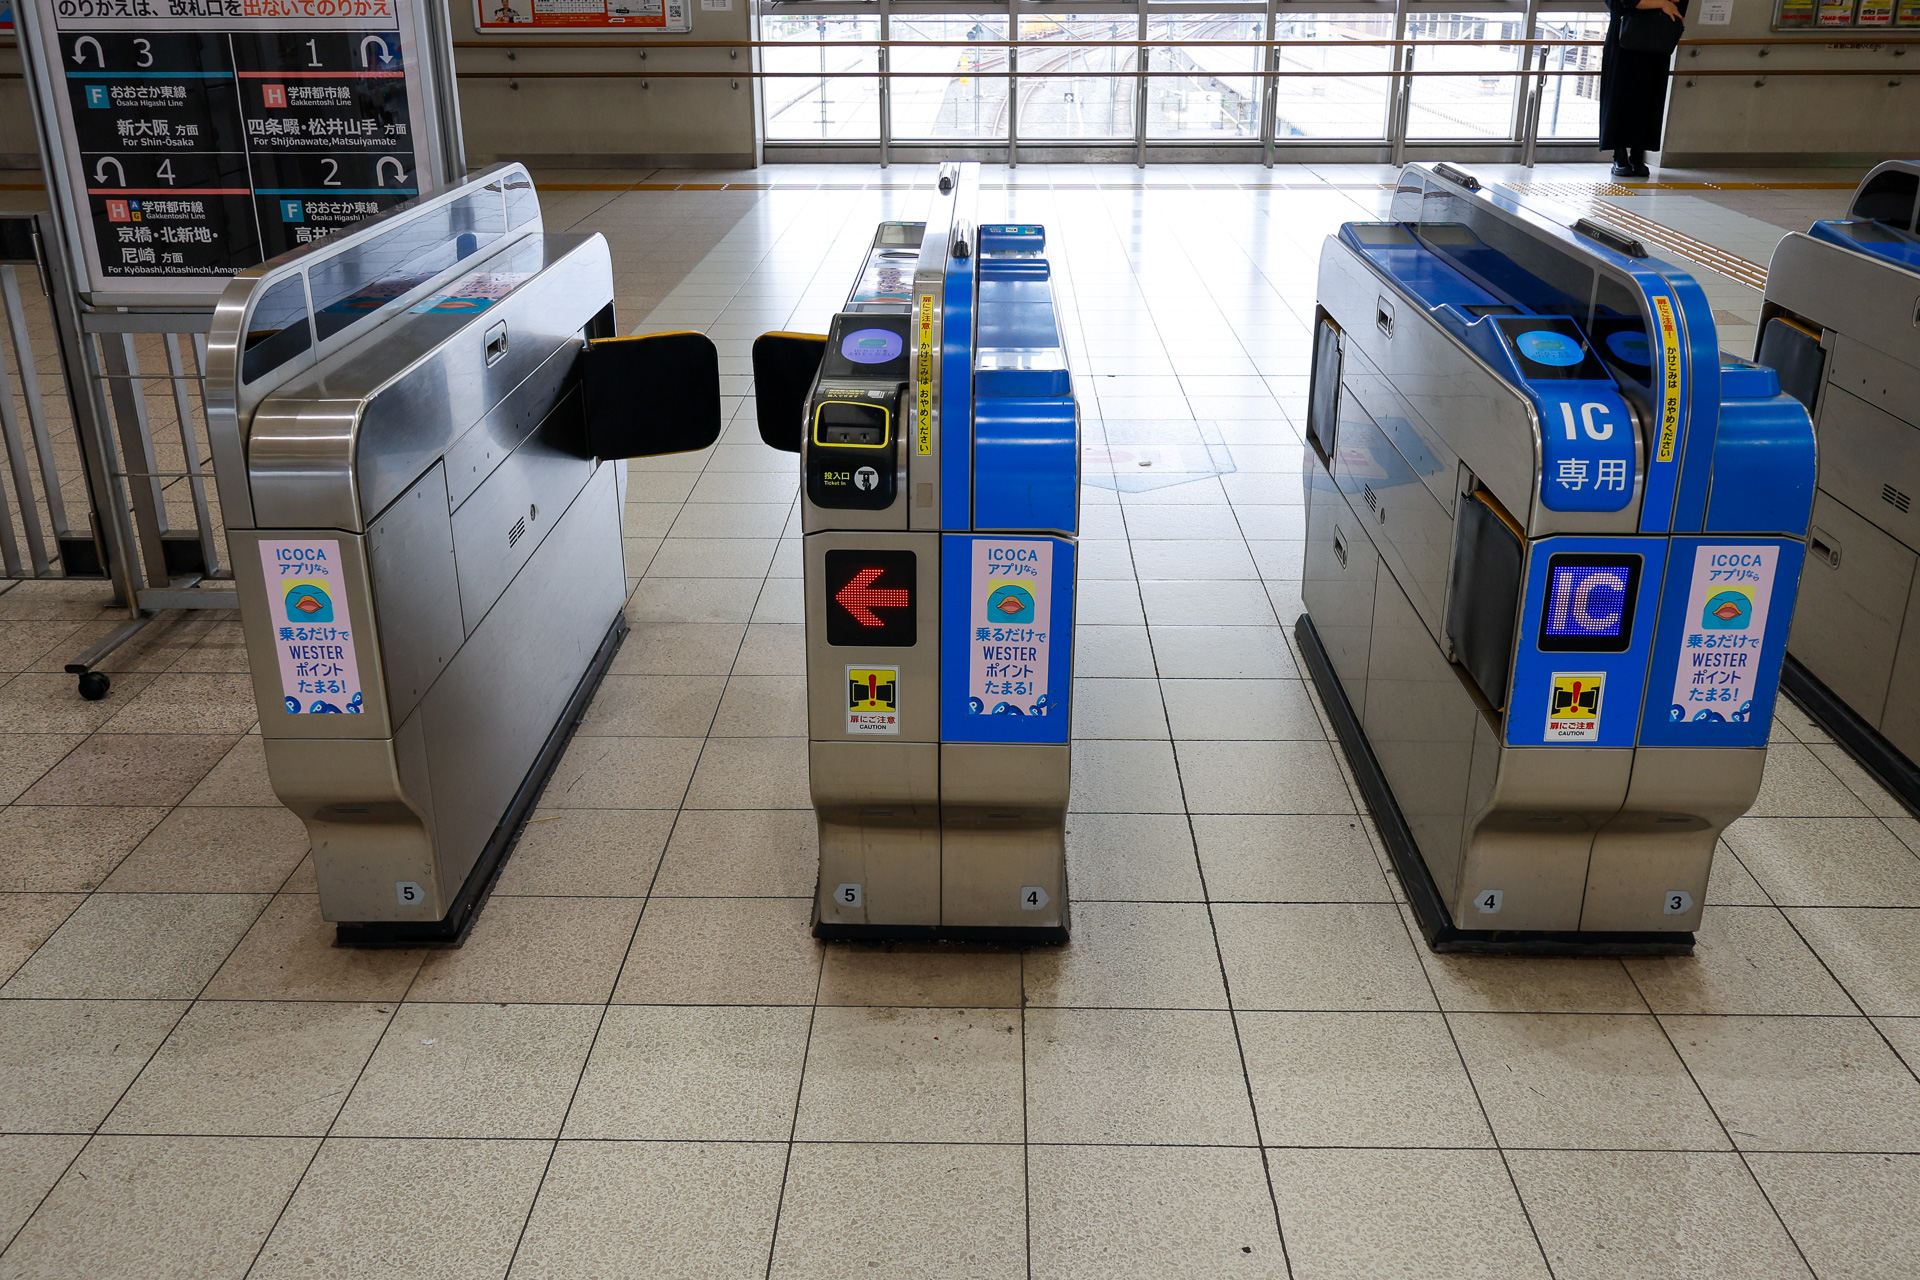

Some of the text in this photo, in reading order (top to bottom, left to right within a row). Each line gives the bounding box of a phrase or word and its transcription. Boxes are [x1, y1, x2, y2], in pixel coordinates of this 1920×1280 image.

[133, 38, 154, 68] 3
[306, 38, 323, 67] 1
[91, 85, 187, 104] F おおさか東線
[267, 86, 351, 104] H 学研都市線
[140, 99, 166, 108] Higashi
[167, 99, 184, 107] Line
[117, 119, 199, 137] 新大阪 方面
[384, 123, 407, 135] 方面
[123, 138, 138, 146] For
[253, 137, 269, 146] For
[156, 158, 176, 186] 4
[320, 158, 342, 186] 2
[111, 203, 126, 218] H
[141, 200, 204, 213] 学研都市線
[287, 203, 298, 218] F
[304, 201, 379, 214] おおさか東線
[334, 213, 361, 222] Higashi
[121, 247, 184, 264] 尼崎 方面
[108, 266, 123, 274] For
[919, 342, 931, 385] かけこみは
[1666, 346, 1678, 389] かけこみは
[918, 389, 930, 452] おやめください
[1559, 402, 1614, 440] IC
[1660, 397, 1677, 458] おやめください
[824, 472, 850, 480] 投入口
[1556, 458, 1627, 491] 専用
[276, 548, 327, 561] ICOCA
[988, 548, 1038, 562] ICOCA
[1711, 554, 1762, 567] ICOCA
[279, 562, 329, 575] アプリなら
[988, 564, 1038, 576] アプリなら
[1709, 569, 1760, 582] アプリなら
[1552, 572, 1624, 630] IC
[279, 626, 350, 641] 乗るだけで
[975, 627, 1046, 643] 乗るだけで
[1687, 634, 1760, 649] 乗るだけで
[289, 645, 344, 660] WESTER
[983, 646, 1037, 662] WESTER
[1692, 652, 1748, 668] WESTER
[296, 662, 344, 677] ポイント
[986, 664, 1034, 679] ポイント
[1692, 670, 1742, 685] ポイント
[850, 715, 896, 724] 扉にご注意
[1549, 721, 1595, 730] 扉にご注意
[403, 886, 415, 901] 5
[844, 888, 856, 903] 5
[1026, 891, 1039, 906] 4
[1483, 894, 1496, 909] 4
[1670, 896, 1682, 910] 3
